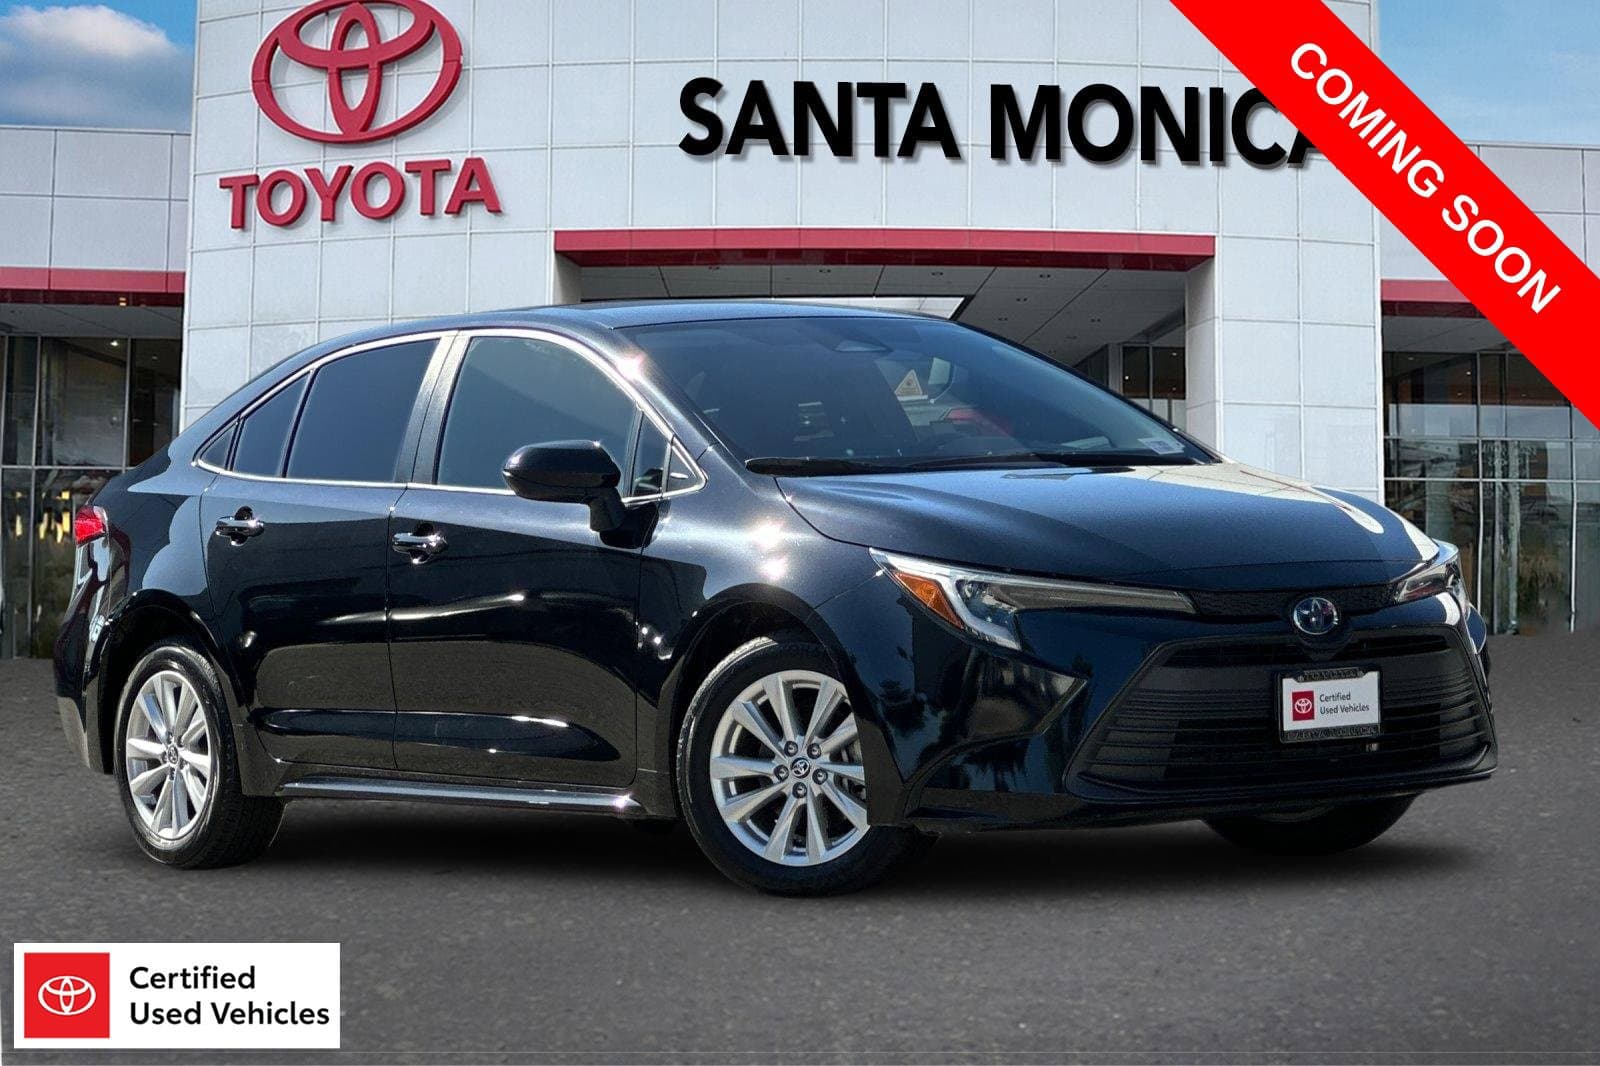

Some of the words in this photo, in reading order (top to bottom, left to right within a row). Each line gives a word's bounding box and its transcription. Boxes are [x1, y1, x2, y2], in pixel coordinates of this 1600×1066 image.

[679, 77, 960, 159] SANTA
[219, 156, 503, 230] TOYOTA
[1319, 691, 1351, 703] Certified
[1320, 705, 1339, 715] Used
[1340, 703, 1370, 714] Vehicles
